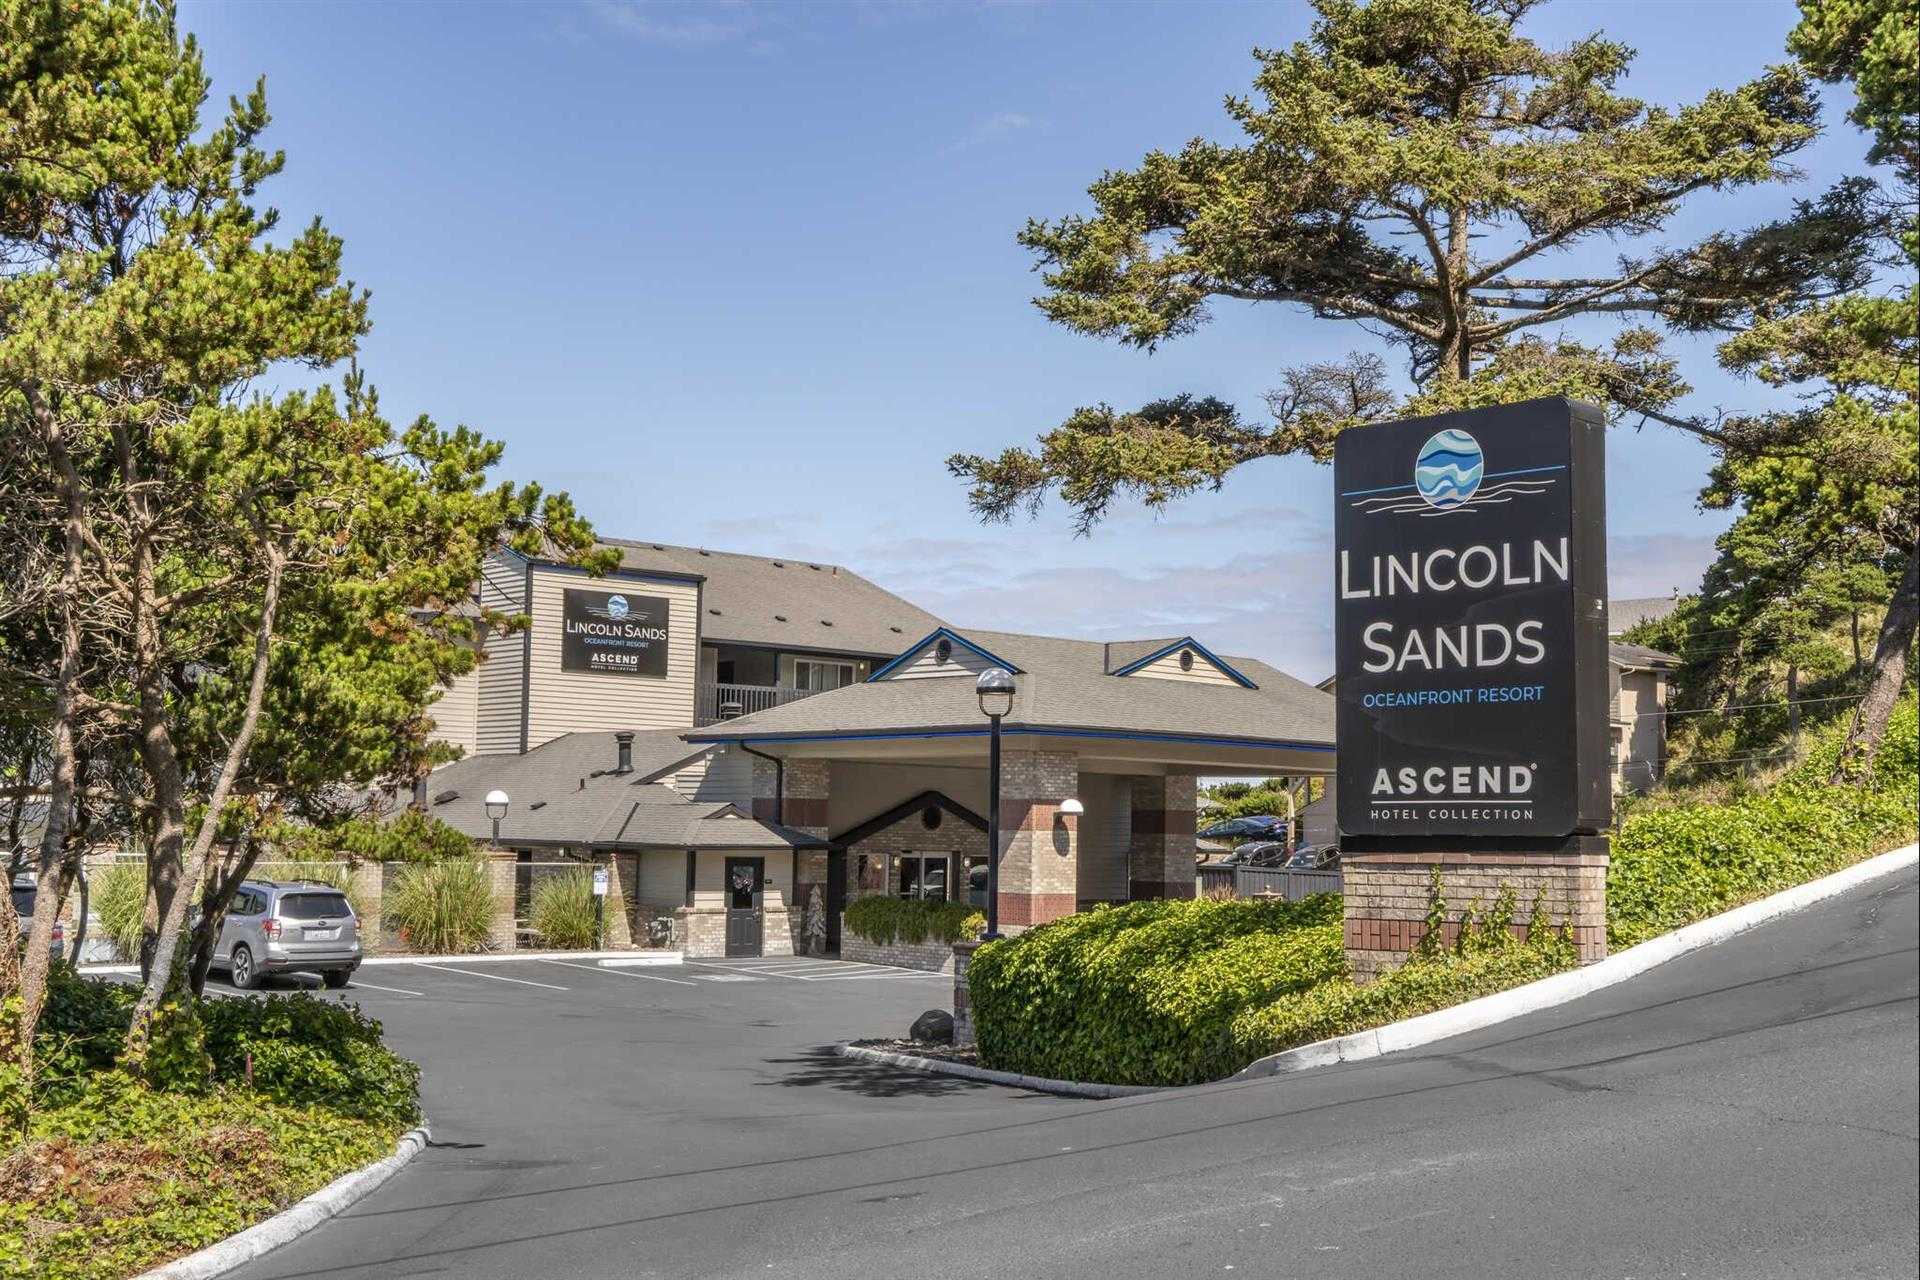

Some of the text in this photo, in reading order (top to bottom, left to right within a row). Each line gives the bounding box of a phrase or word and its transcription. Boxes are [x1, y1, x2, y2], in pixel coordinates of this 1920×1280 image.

[1341, 537, 1569, 600] LINCOLN
[566, 619, 667, 641] LINCOLN SANDS
[1362, 620, 1546, 674] SANDS
[1363, 685, 1545, 708] OCEANFRONT RESORT
[1371, 808, 1534, 821] HOTEL COLLECTION
